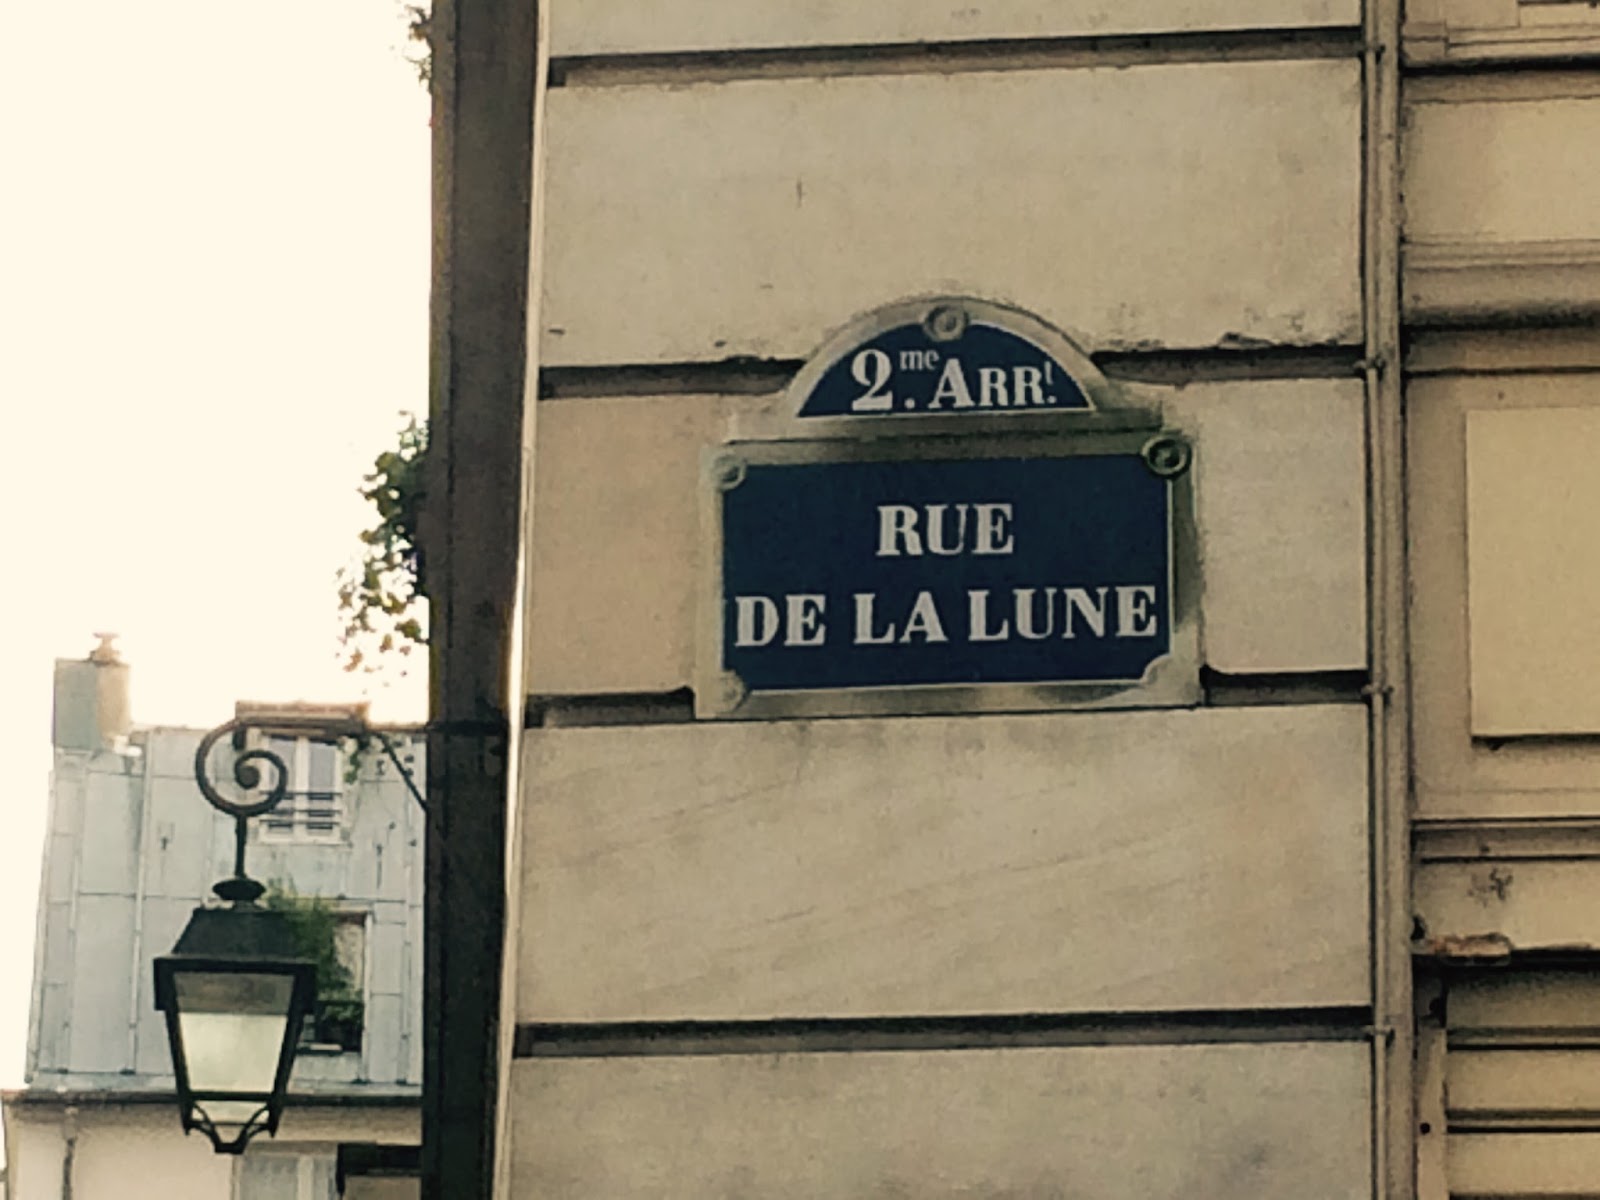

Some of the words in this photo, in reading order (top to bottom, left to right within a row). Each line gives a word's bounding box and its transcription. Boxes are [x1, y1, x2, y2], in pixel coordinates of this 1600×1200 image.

[877, 503, 1015, 556] RUE
[735, 594, 826, 648] DE
[854, 590, 948, 646] LA
[967, 585, 1158, 643] LUNE
